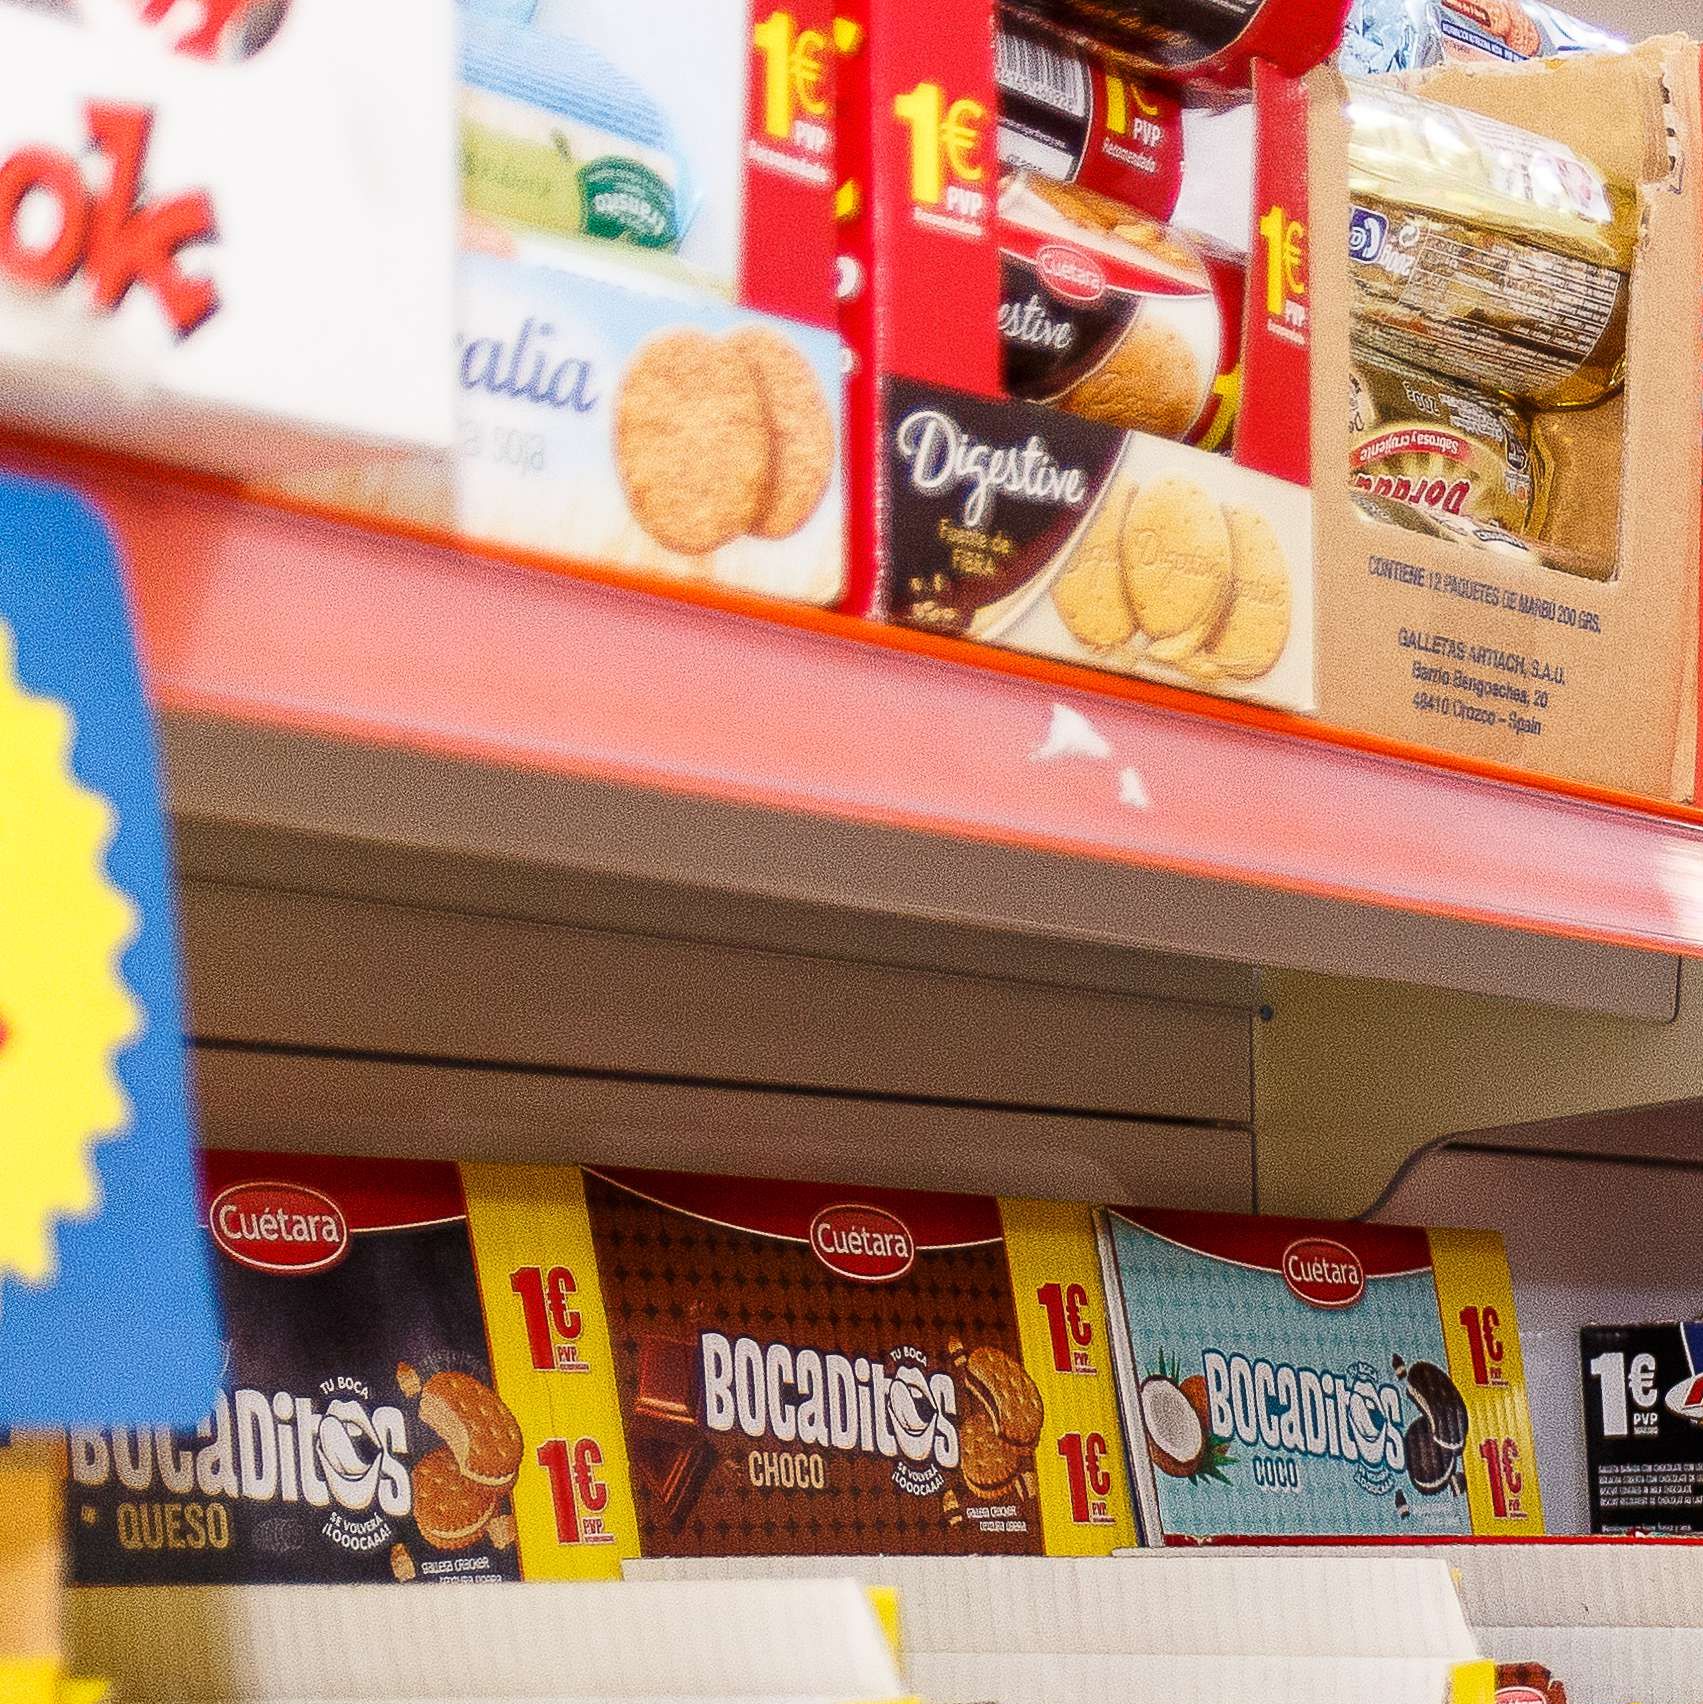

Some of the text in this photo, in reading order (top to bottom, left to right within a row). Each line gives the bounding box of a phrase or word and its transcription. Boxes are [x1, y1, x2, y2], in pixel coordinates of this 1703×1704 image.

[893, 83, 985, 203] 1€
[899, 408, 1087, 527] Digestive
[217, 1203, 341, 1247] Cuétara
[817, 1221, 909, 1259] Cuétara
[1288, 1254, 1361, 1286] Cuétara
[508, 1265, 584, 1372] 1€
[1037, 1282, 1094, 1374] 1€
[1459, 1304, 1505, 1387] 1€
[1590, 1351, 1659, 1438] 1€
[1632, 1412, 1659, 1427] PVP
[537, 1436, 609, 1546] 1€
[747, 1449, 826, 1490] CHOCO
[1057, 1432, 1113, 1525] 1€
[1254, 1454, 1300, 1490] COCO
[1480, 1436, 1524, 1519] 1€
[117, 1502, 232, 1553] QUESO
